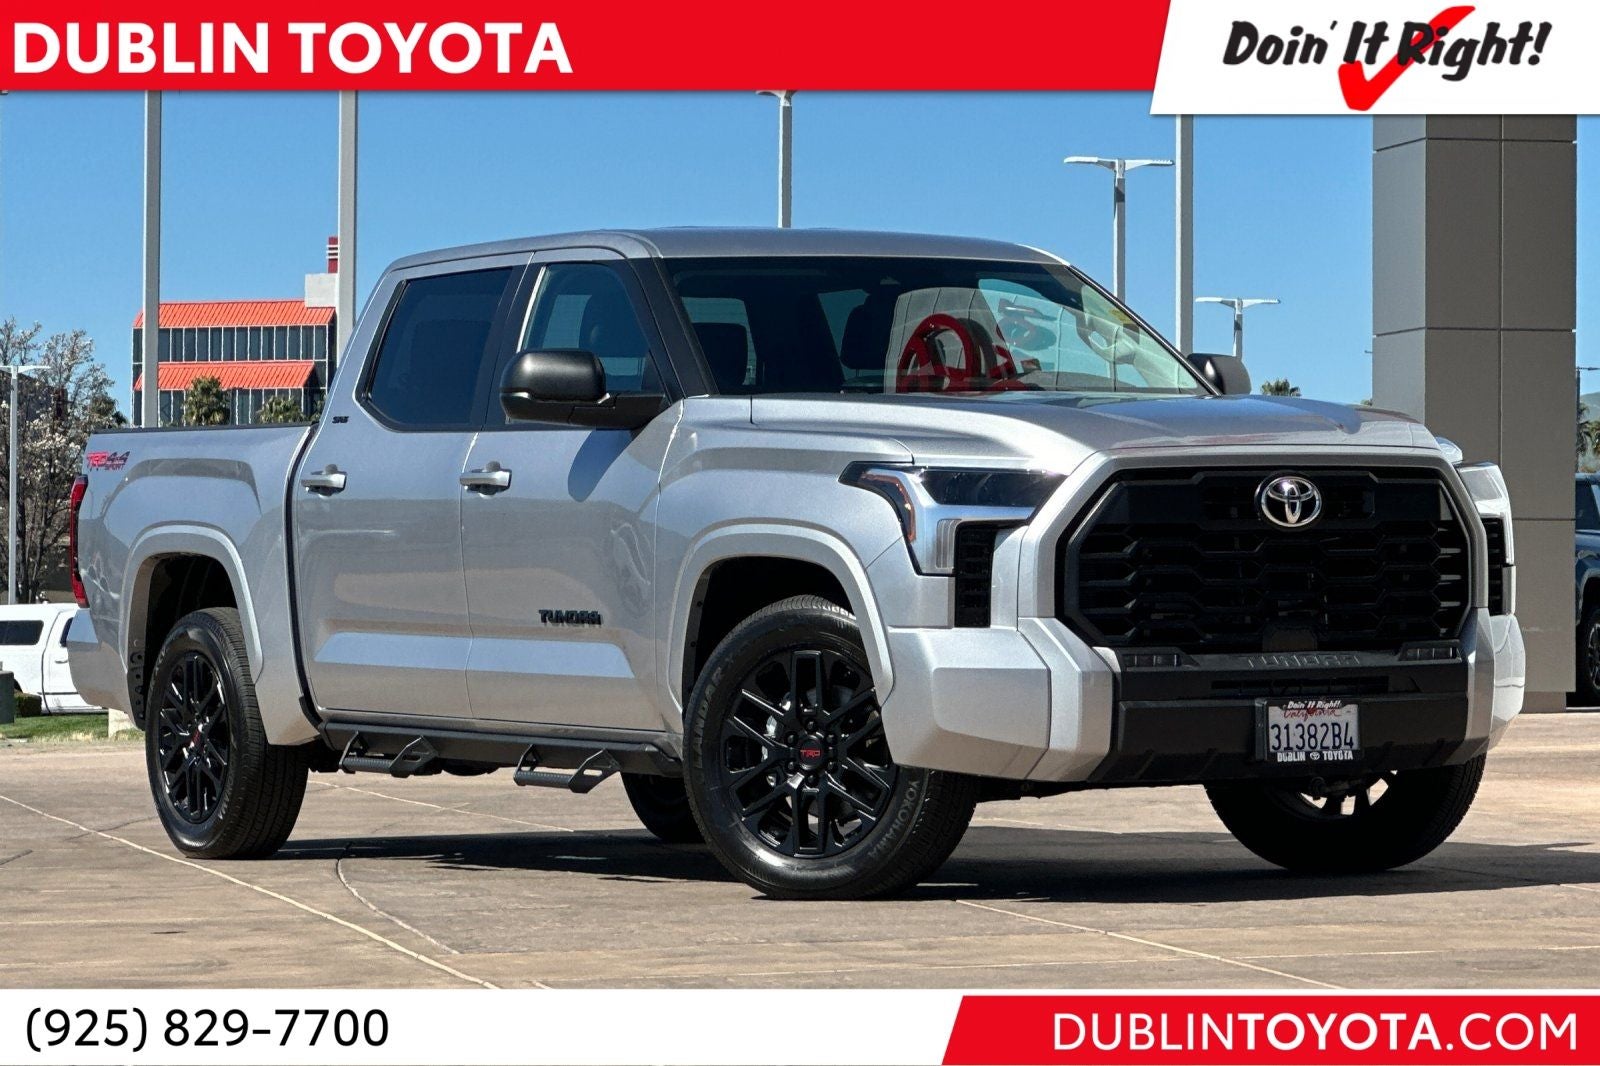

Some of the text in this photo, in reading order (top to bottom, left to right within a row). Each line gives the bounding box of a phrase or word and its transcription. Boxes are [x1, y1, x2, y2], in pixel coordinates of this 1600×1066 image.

[538, 609, 602, 625] TUNDRA
[1270, 722, 1354, 751] 31382B4
[800, 749, 821, 758] TRD
[1277, 750, 1354, 762] DUBLIN TOYOTA
